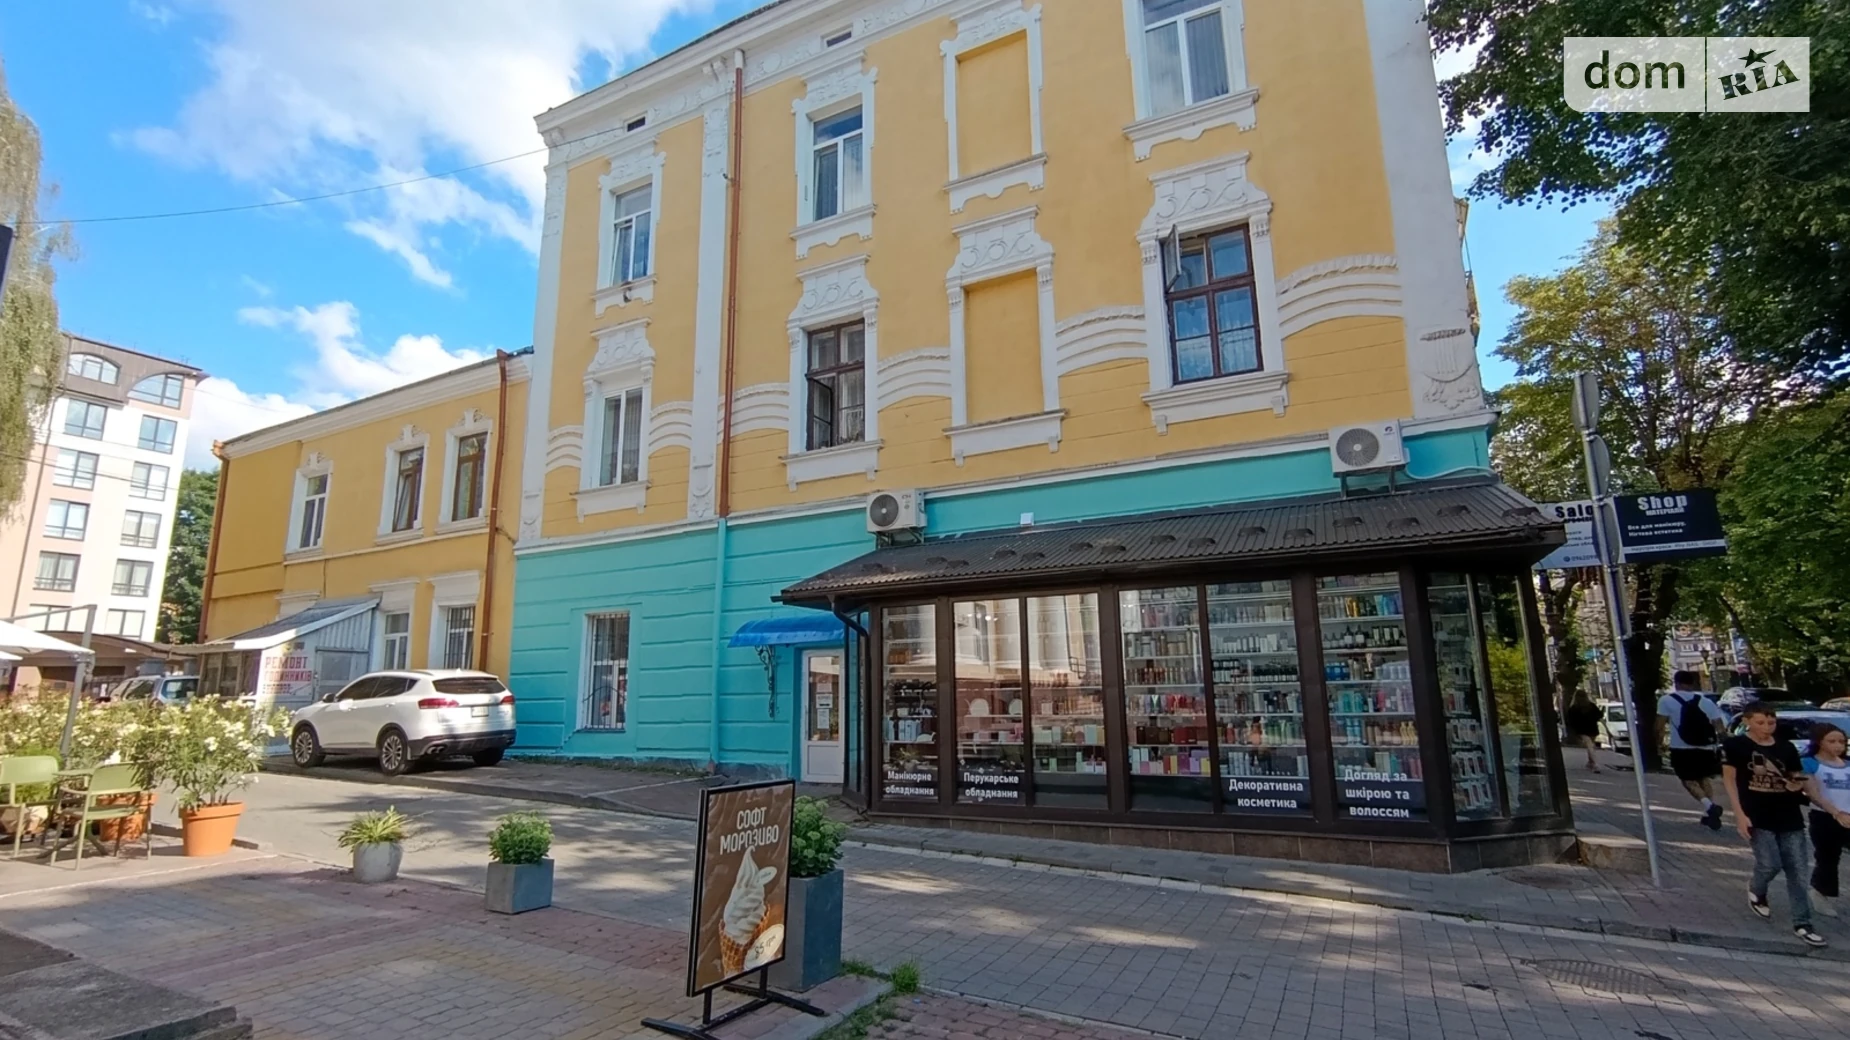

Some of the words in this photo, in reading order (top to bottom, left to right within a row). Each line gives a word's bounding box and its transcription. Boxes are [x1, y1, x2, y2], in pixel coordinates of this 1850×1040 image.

[1637, 495, 1688, 510] Shop
[887, 770, 932, 783] Манікюрне
[963, 772, 1019, 785] Перукарське
[1344, 768, 1390, 783] Догляд
[1394, 773, 1408, 782] за
[885, 785, 934, 796] обладнання
[1228, 778, 1304, 793] Декоративна
[965, 787, 1018, 799] обладнання
[1345, 786, 1391, 801] шкірою
[1396, 791, 1410, 800] та
[1237, 797, 1297, 809] косметика
[736, 806, 767, 830] СОФТ
[1349, 806, 1409, 818] волоссям
[719, 824, 779, 855] МОРОЗИВО
